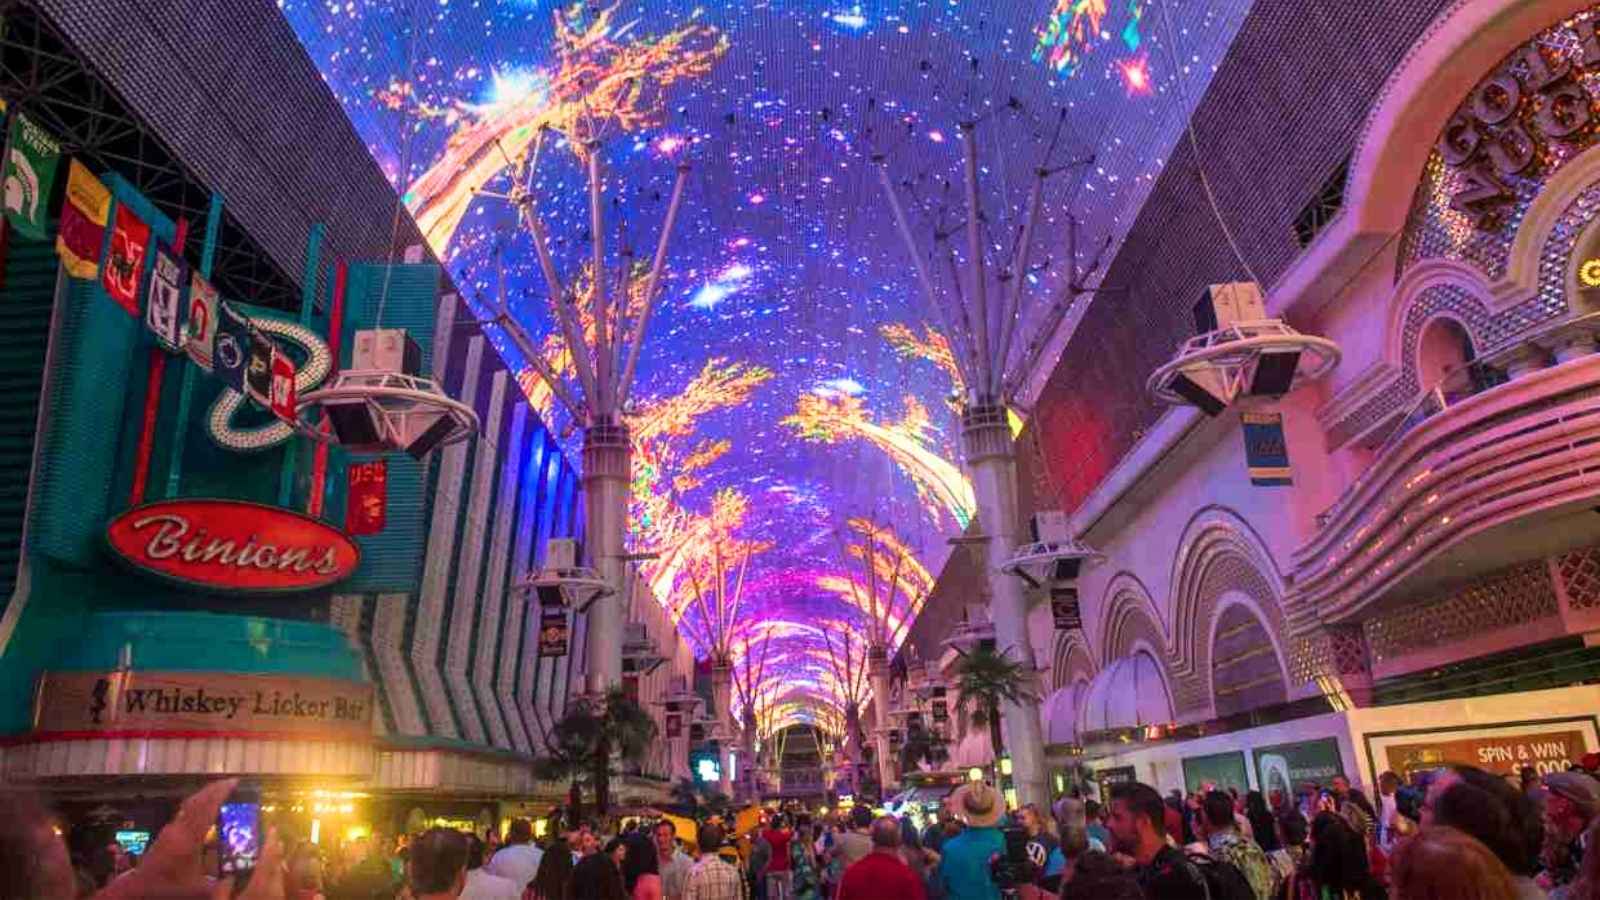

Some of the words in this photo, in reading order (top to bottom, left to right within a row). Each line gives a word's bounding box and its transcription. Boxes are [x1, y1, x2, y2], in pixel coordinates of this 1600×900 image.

[125, 688, 243, 718] Whiskey
[253, 692, 329, 718] Licker
[335, 697, 362, 720] Bar
[1477, 746, 1514, 763] SPIN
[1518, 744, 1529, 760] &
[1530, 741, 1567, 759] WIN
